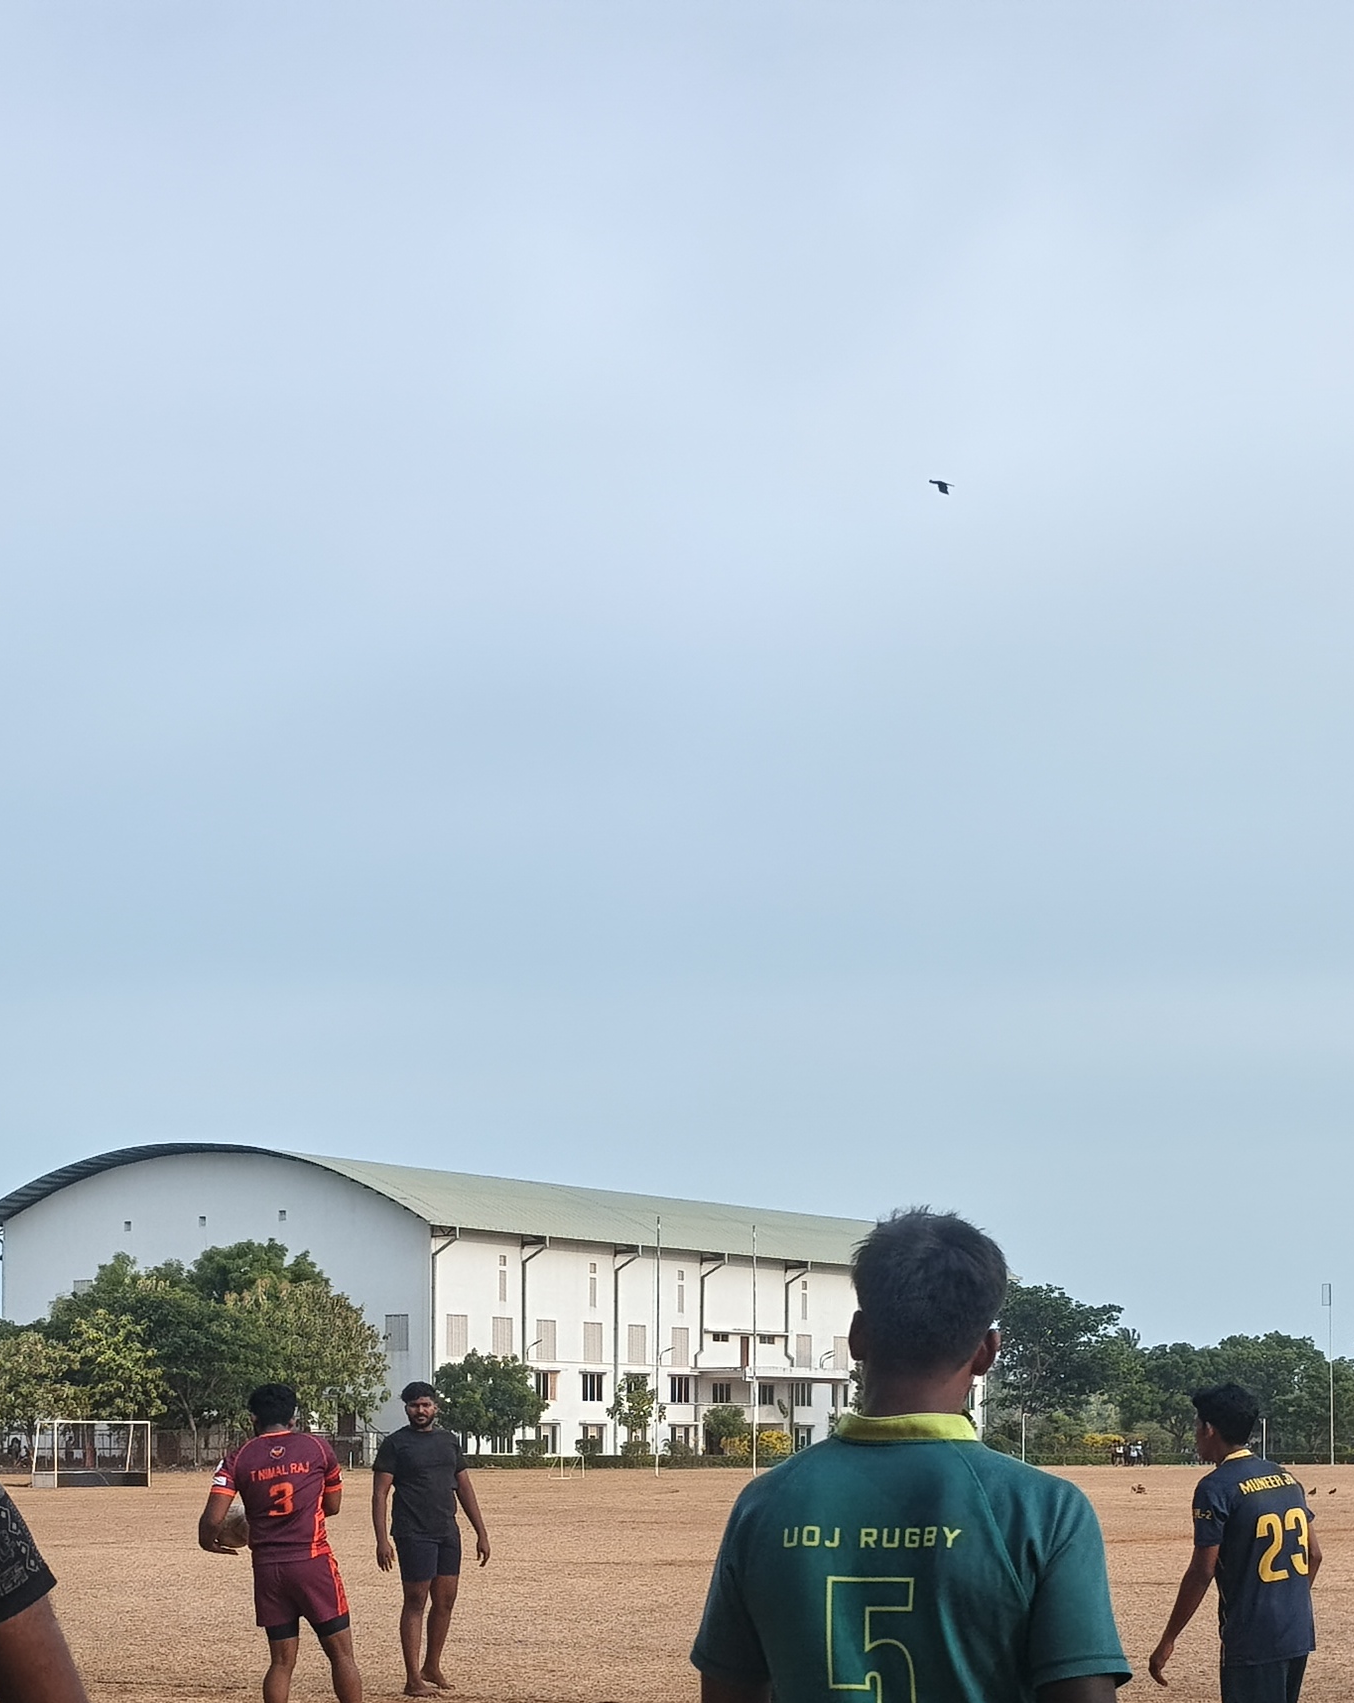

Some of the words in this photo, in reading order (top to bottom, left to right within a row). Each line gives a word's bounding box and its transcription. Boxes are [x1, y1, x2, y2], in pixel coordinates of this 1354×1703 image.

[250, 1470, 256, 1481] T
[258, 1464, 289, 1480] NIMAL
[290, 1461, 310, 1474] RAJ
[1239, 1474, 1285, 1495] MUNEER
[268, 1481, 294, 1516] 3
[783, 1526, 841, 1548] UOJ
[860, 1526, 962, 1549] RUGBY
[1256, 1507, 1309, 1582] 23
